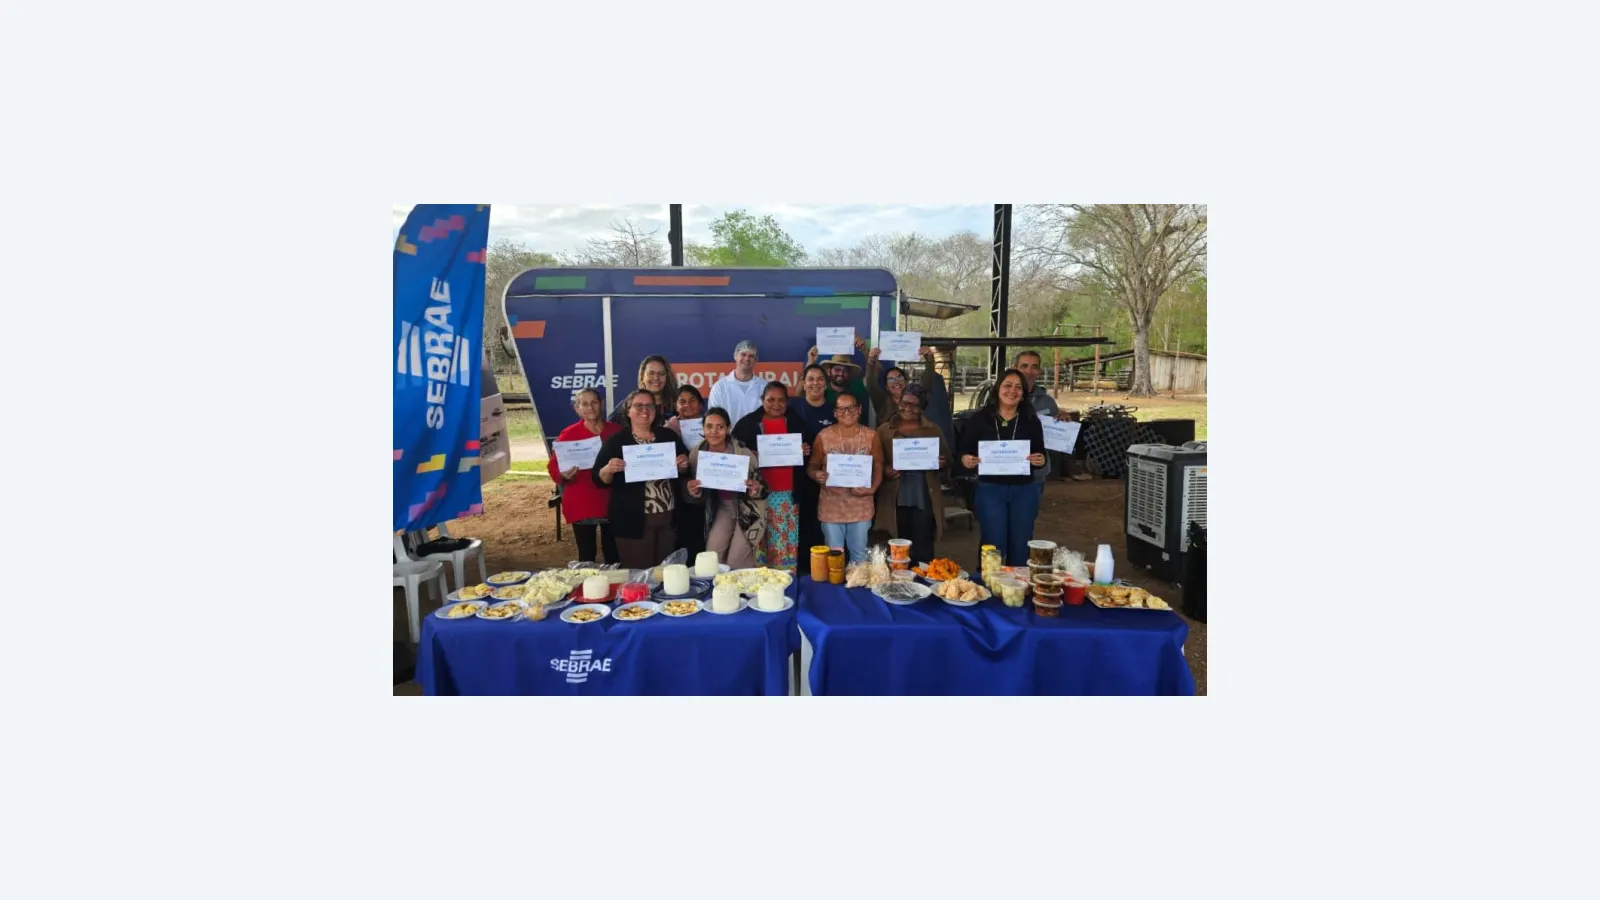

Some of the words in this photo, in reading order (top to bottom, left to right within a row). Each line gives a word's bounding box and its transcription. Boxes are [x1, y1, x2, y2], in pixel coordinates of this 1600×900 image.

[424, 276, 454, 430] SEBRAE
[551, 374, 619, 389] SEBRAE
[676, 371, 726, 389] ROT
[550, 658, 612, 673] SEBRAE
